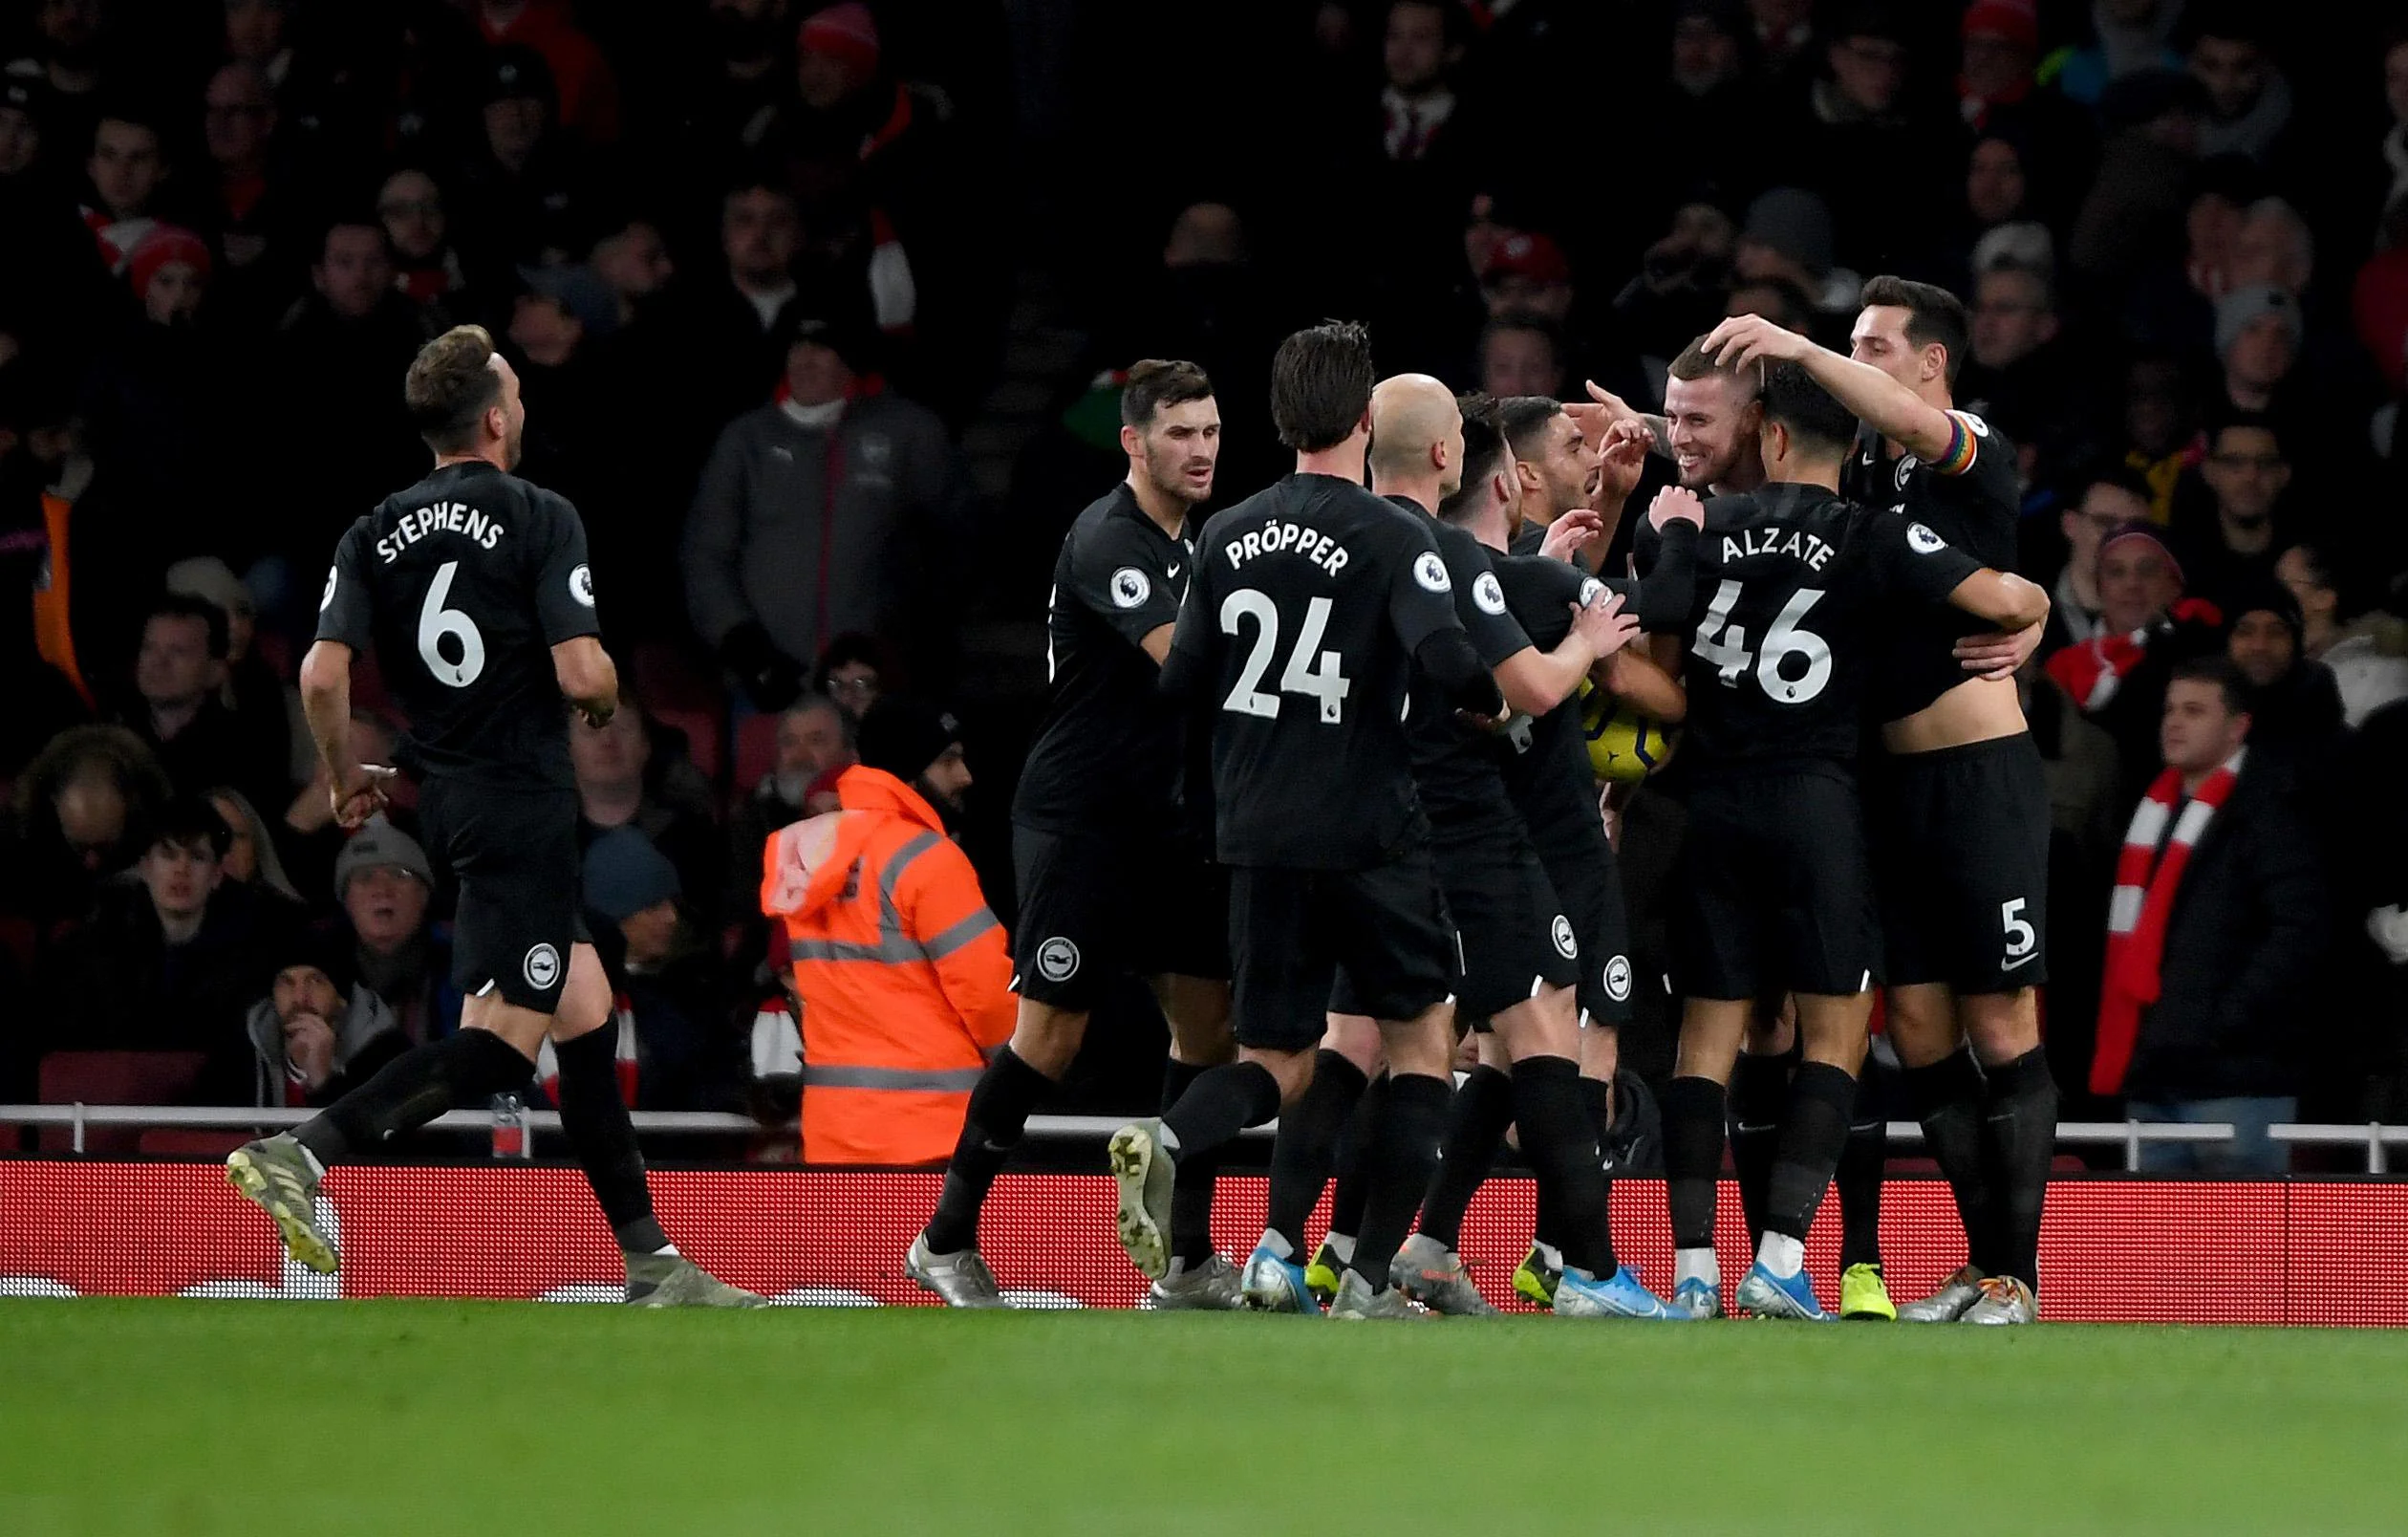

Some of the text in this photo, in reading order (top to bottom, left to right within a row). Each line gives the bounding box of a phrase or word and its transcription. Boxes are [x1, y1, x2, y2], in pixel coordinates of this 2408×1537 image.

[376, 501, 505, 564] STEPHENS
[1225, 518, 1349, 577] PRÖPPER
[1722, 527, 1836, 572] ALZATE
[418, 560, 485, 688] 6
[1690, 578, 1833, 704] 46
[1219, 588, 1351, 725] 24
[2001, 897, 2035, 956] 5
